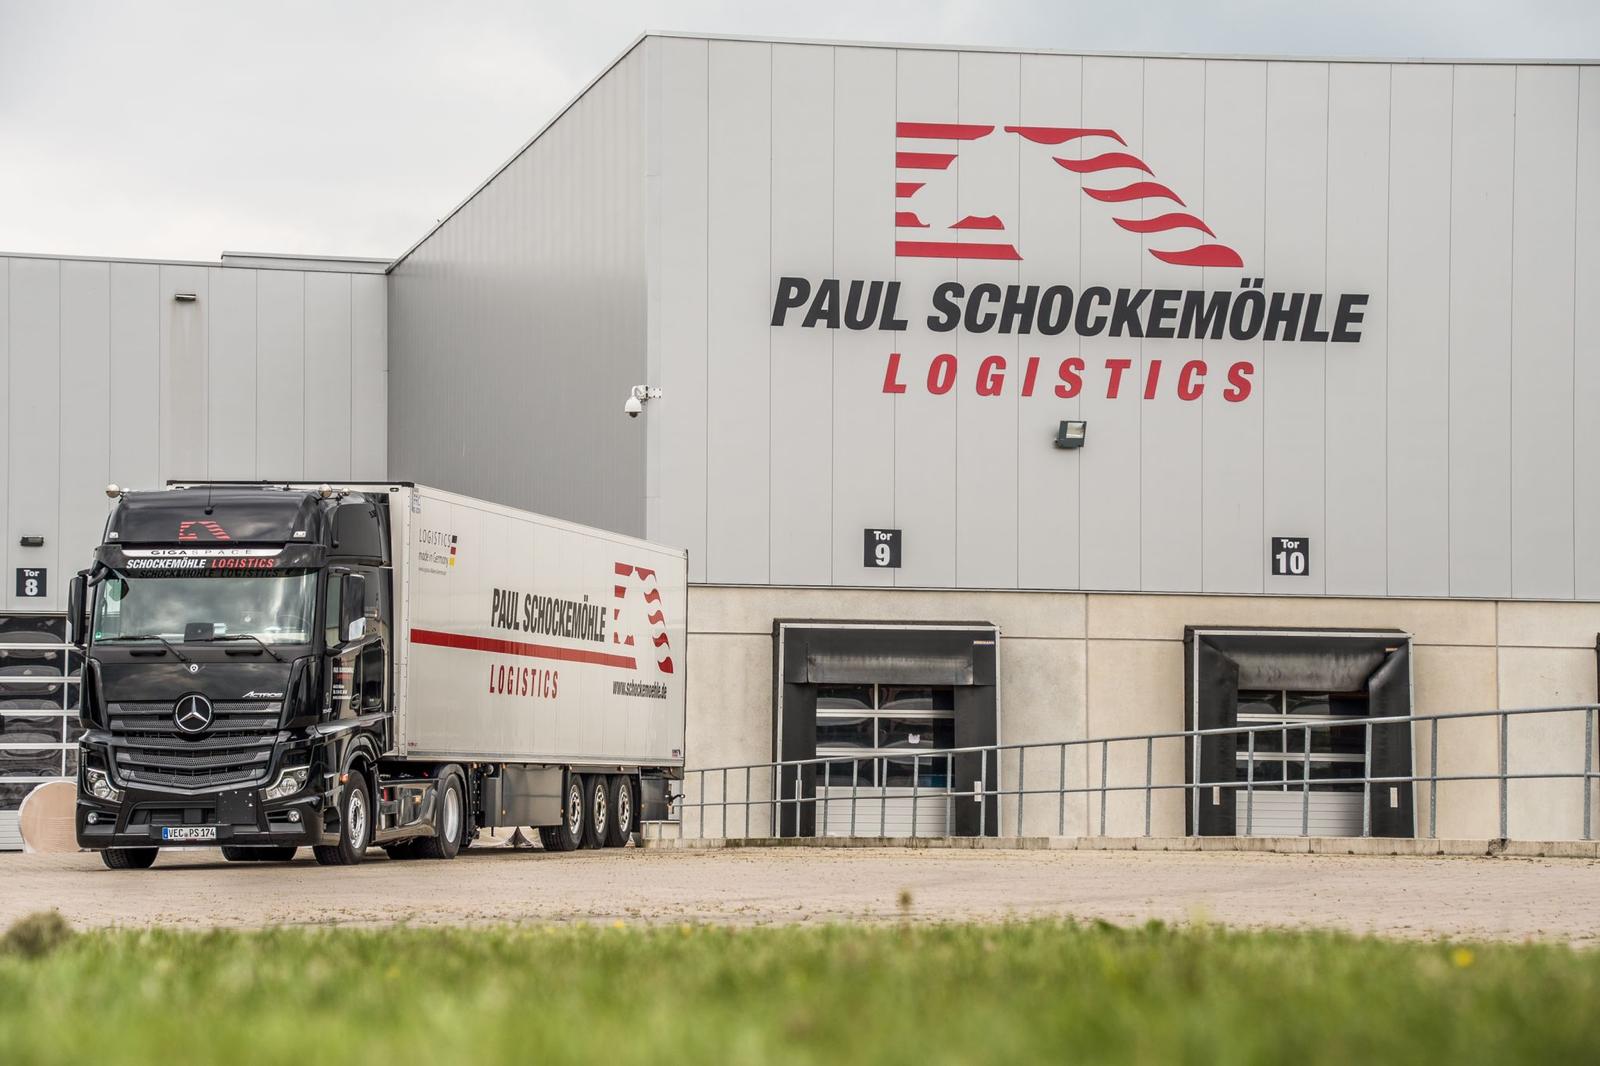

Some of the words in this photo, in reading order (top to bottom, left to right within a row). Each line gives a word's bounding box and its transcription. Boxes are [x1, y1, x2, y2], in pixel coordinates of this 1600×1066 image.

[771, 277, 908, 331] PAUL
[926, 278, 1369, 343] SCHOCKEMÖHLE
[882, 353, 1255, 402] LOGISTICS
[873, 531, 893, 541] Tor
[1281, 539, 1300, 549] Tor
[126, 557, 207, 569] SCHOCKEMÖHLE
[211, 558, 275, 568] LOGISTICS
[875, 543, 890, 566] 9
[1276, 551, 1305, 574] 10
[23, 569, 40, 577] Tor
[25, 578, 38, 596] 8
[491, 588, 520, 630] PAUL
[523, 594, 607, 642] SCHOCKEMÖHLE
[489, 664, 559, 699] LOGISTICS
[169, 828, 183, 838] VEC
[189, 828, 200, 838] PS
[201, 828, 215, 838] 174
